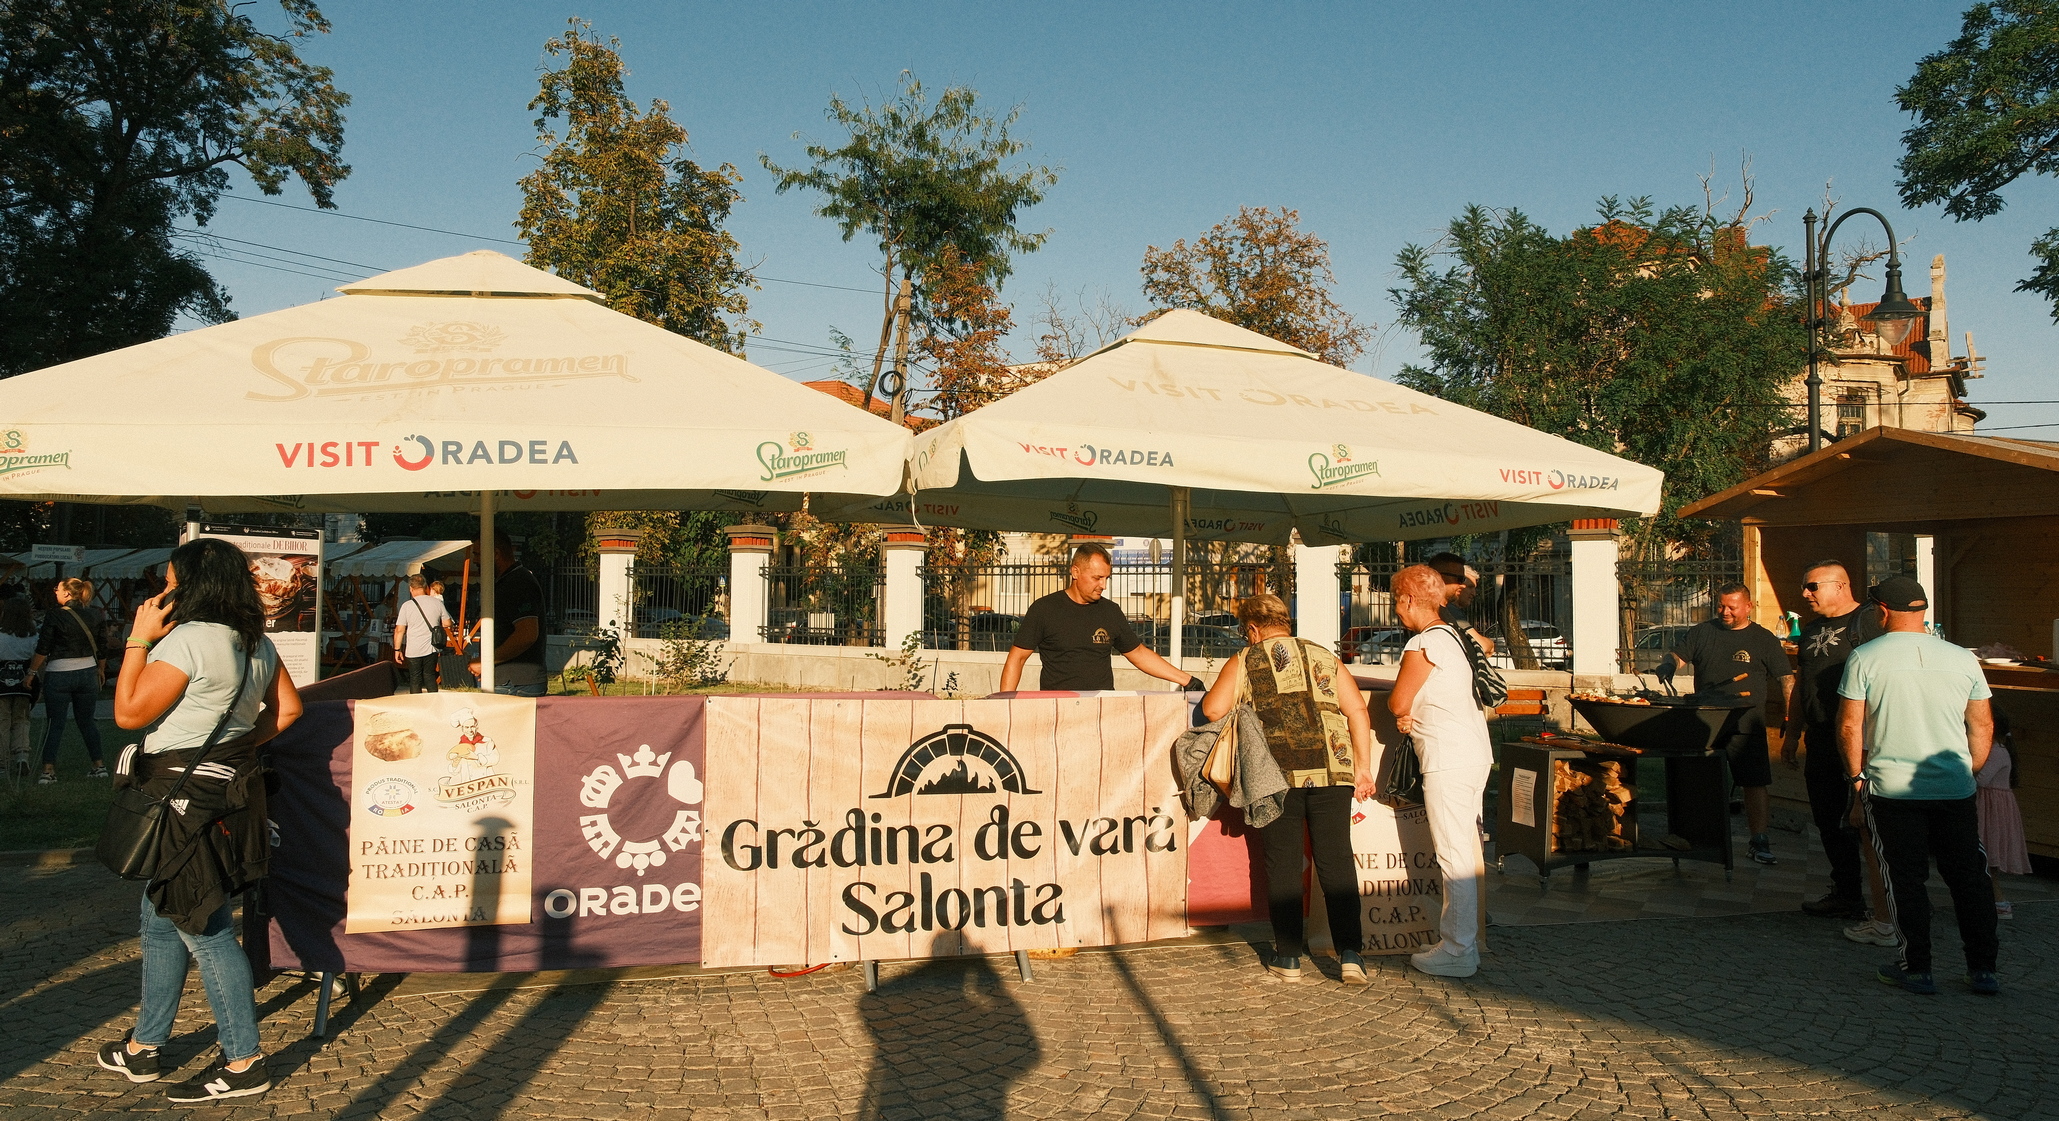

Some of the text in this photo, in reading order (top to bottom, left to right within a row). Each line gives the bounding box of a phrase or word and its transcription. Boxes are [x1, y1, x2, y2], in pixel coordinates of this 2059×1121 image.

[243, 337, 642, 402] Staropramen
[452, 383, 546, 394] PRAGUE
[1107, 376, 1222, 401] VISIT
[0, 451, 71, 470] opramen
[275, 433, 579, 472] VISIT ORADEA
[756, 441, 848, 482] Staropramen
[1017, 441, 1174, 467] VISIT ORADEA
[12, 469, 41, 479] PRAGUE
[803, 470, 826, 479] PRAGUE
[1308, 452, 1381, 490] Staropramen
[1499, 468, 1619, 491] VISIT ORADEA
[365, 778, 386, 795] PRODUS
[444, 777, 508, 798] VESPAN
[454, 795, 497, 810] SALONTA
[466, 803, 489, 814] C.A.P.
[1402, 809, 1427, 820] SALO
[432, 837, 458, 853] DE
[720, 807, 955, 871] Grădina
[974, 804, 1042, 862] de
[1385, 852, 1408, 870] DE
[1413, 851, 1442, 869] CA
[411, 883, 470, 901] C.A.P.
[841, 872, 1066, 936] Salonta
[1368, 905, 1426, 924] C.A.P.
